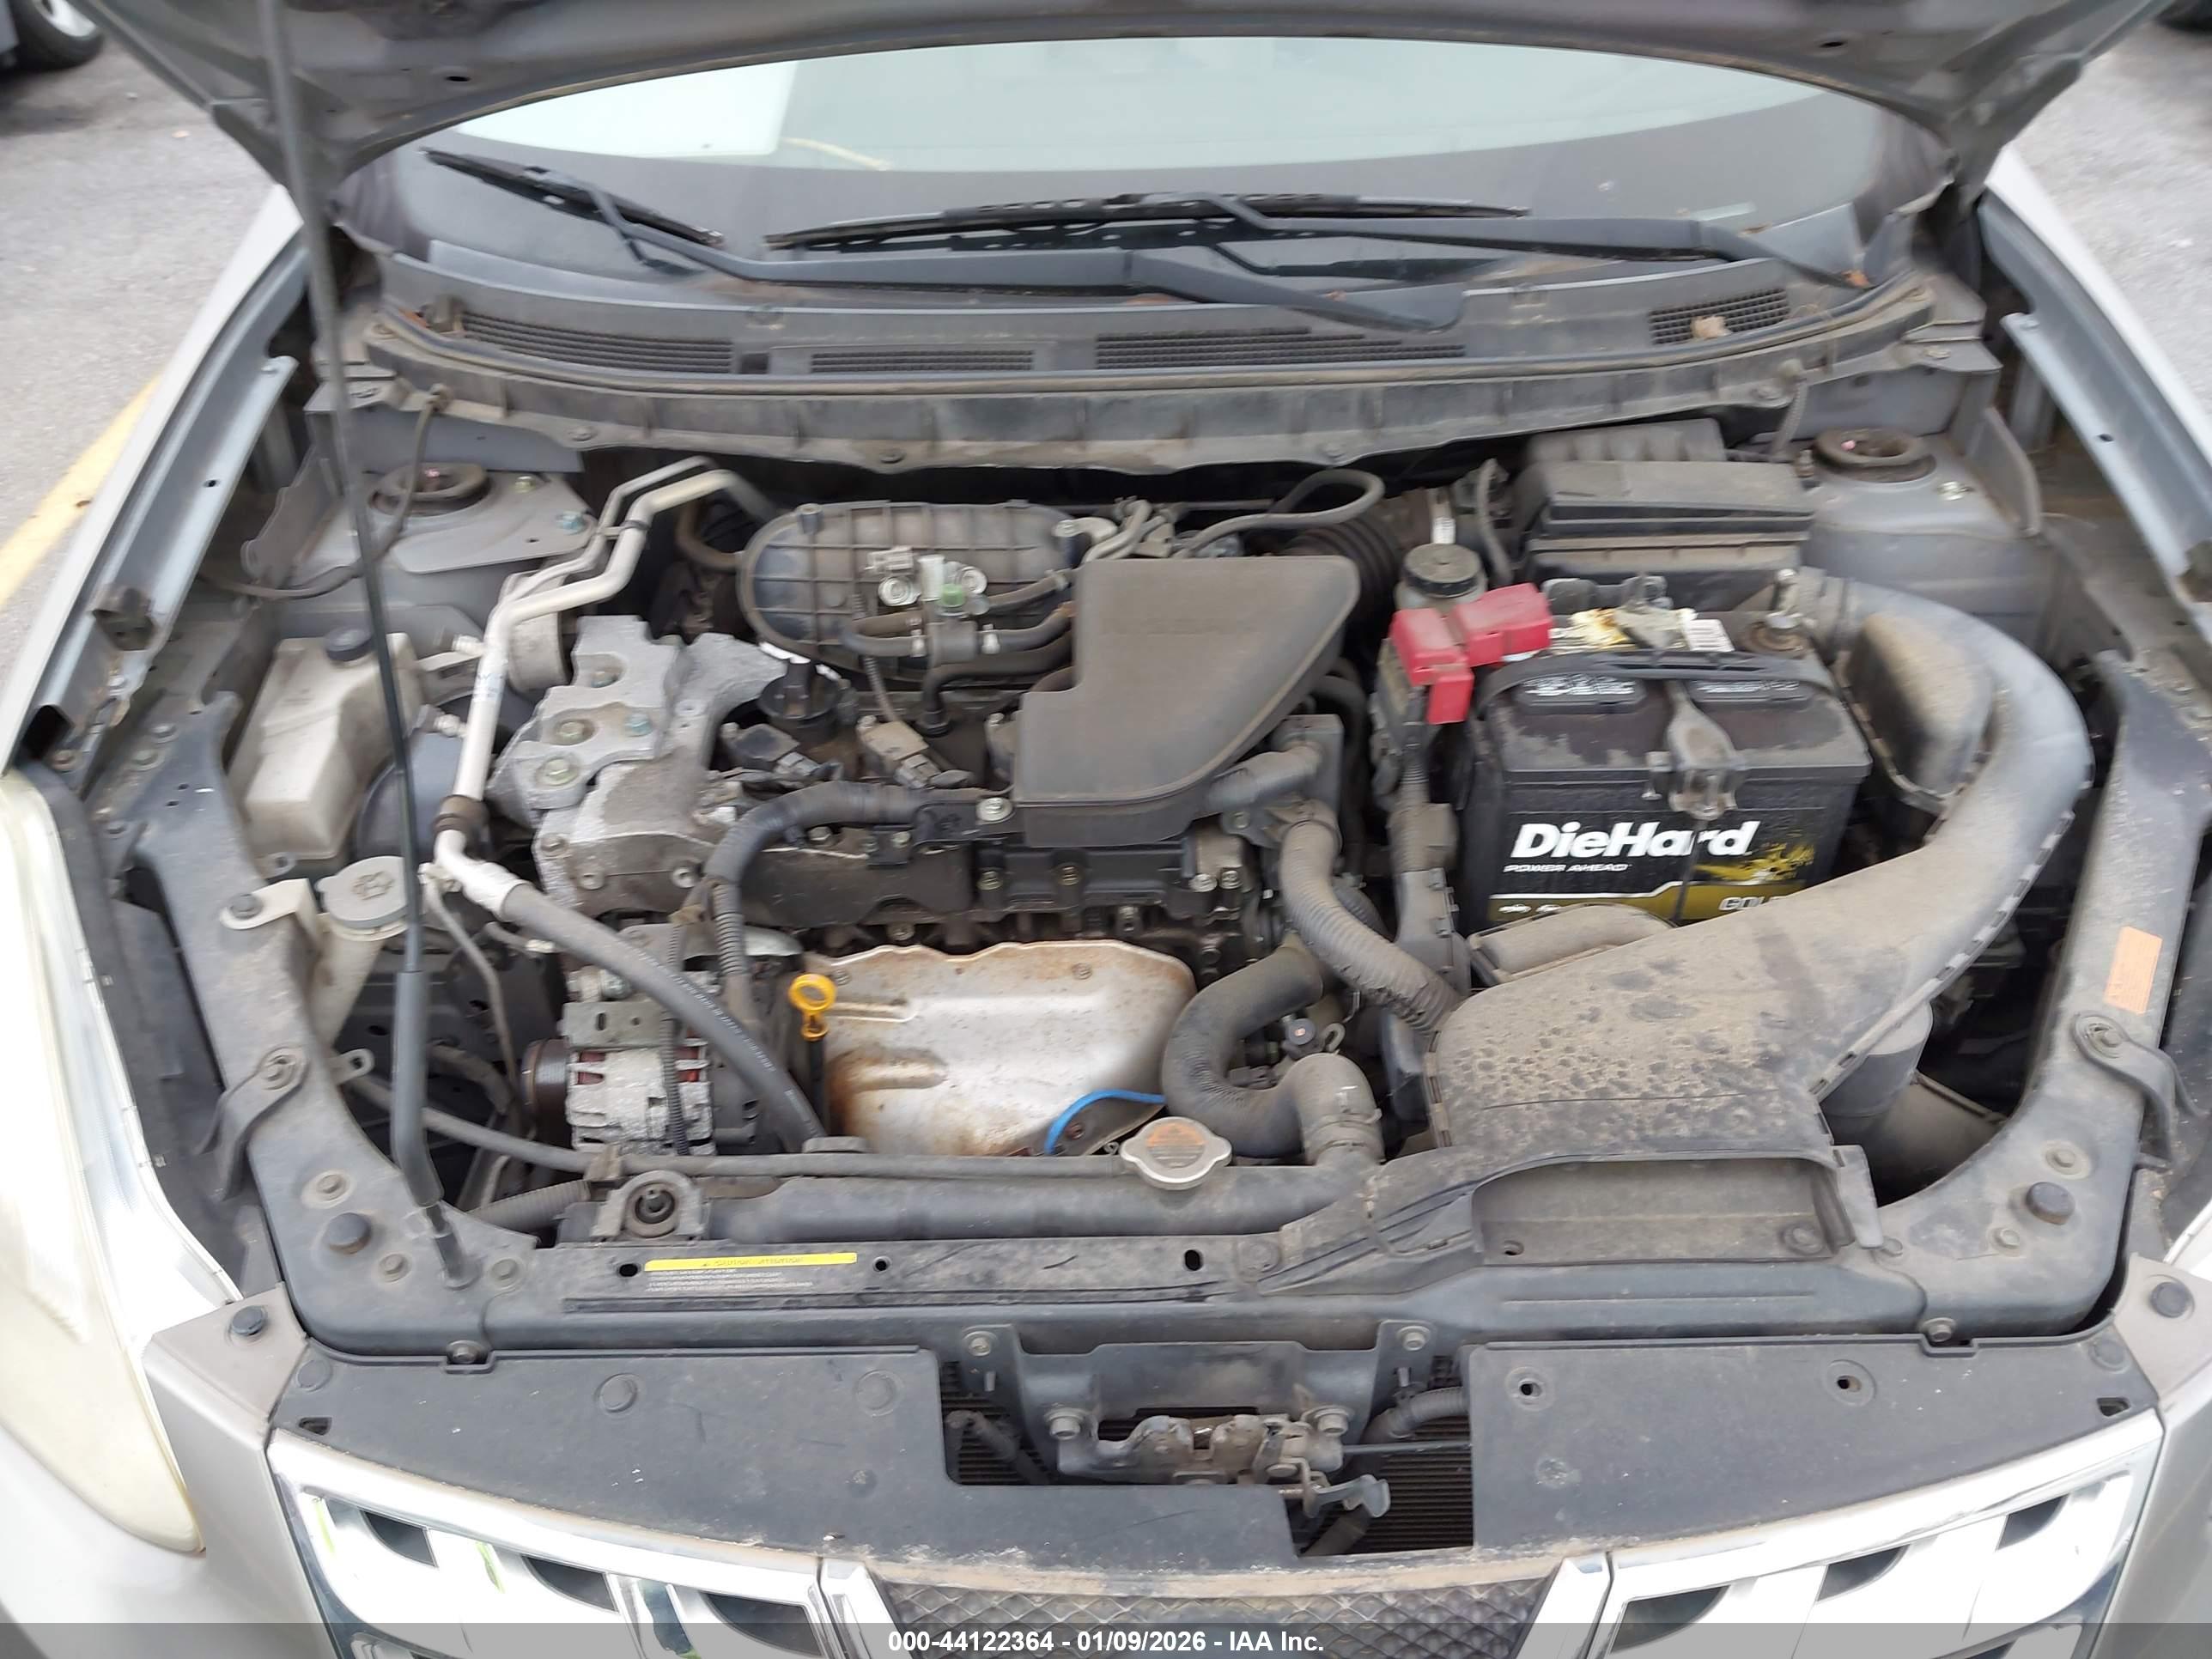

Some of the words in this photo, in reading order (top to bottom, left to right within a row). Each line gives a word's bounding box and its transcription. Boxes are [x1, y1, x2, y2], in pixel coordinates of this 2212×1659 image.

[1510, 821, 1760, 858] DieHard
[1503, 864, 1565, 872] POWER
[1566, 863, 1628, 872] AHEAD
